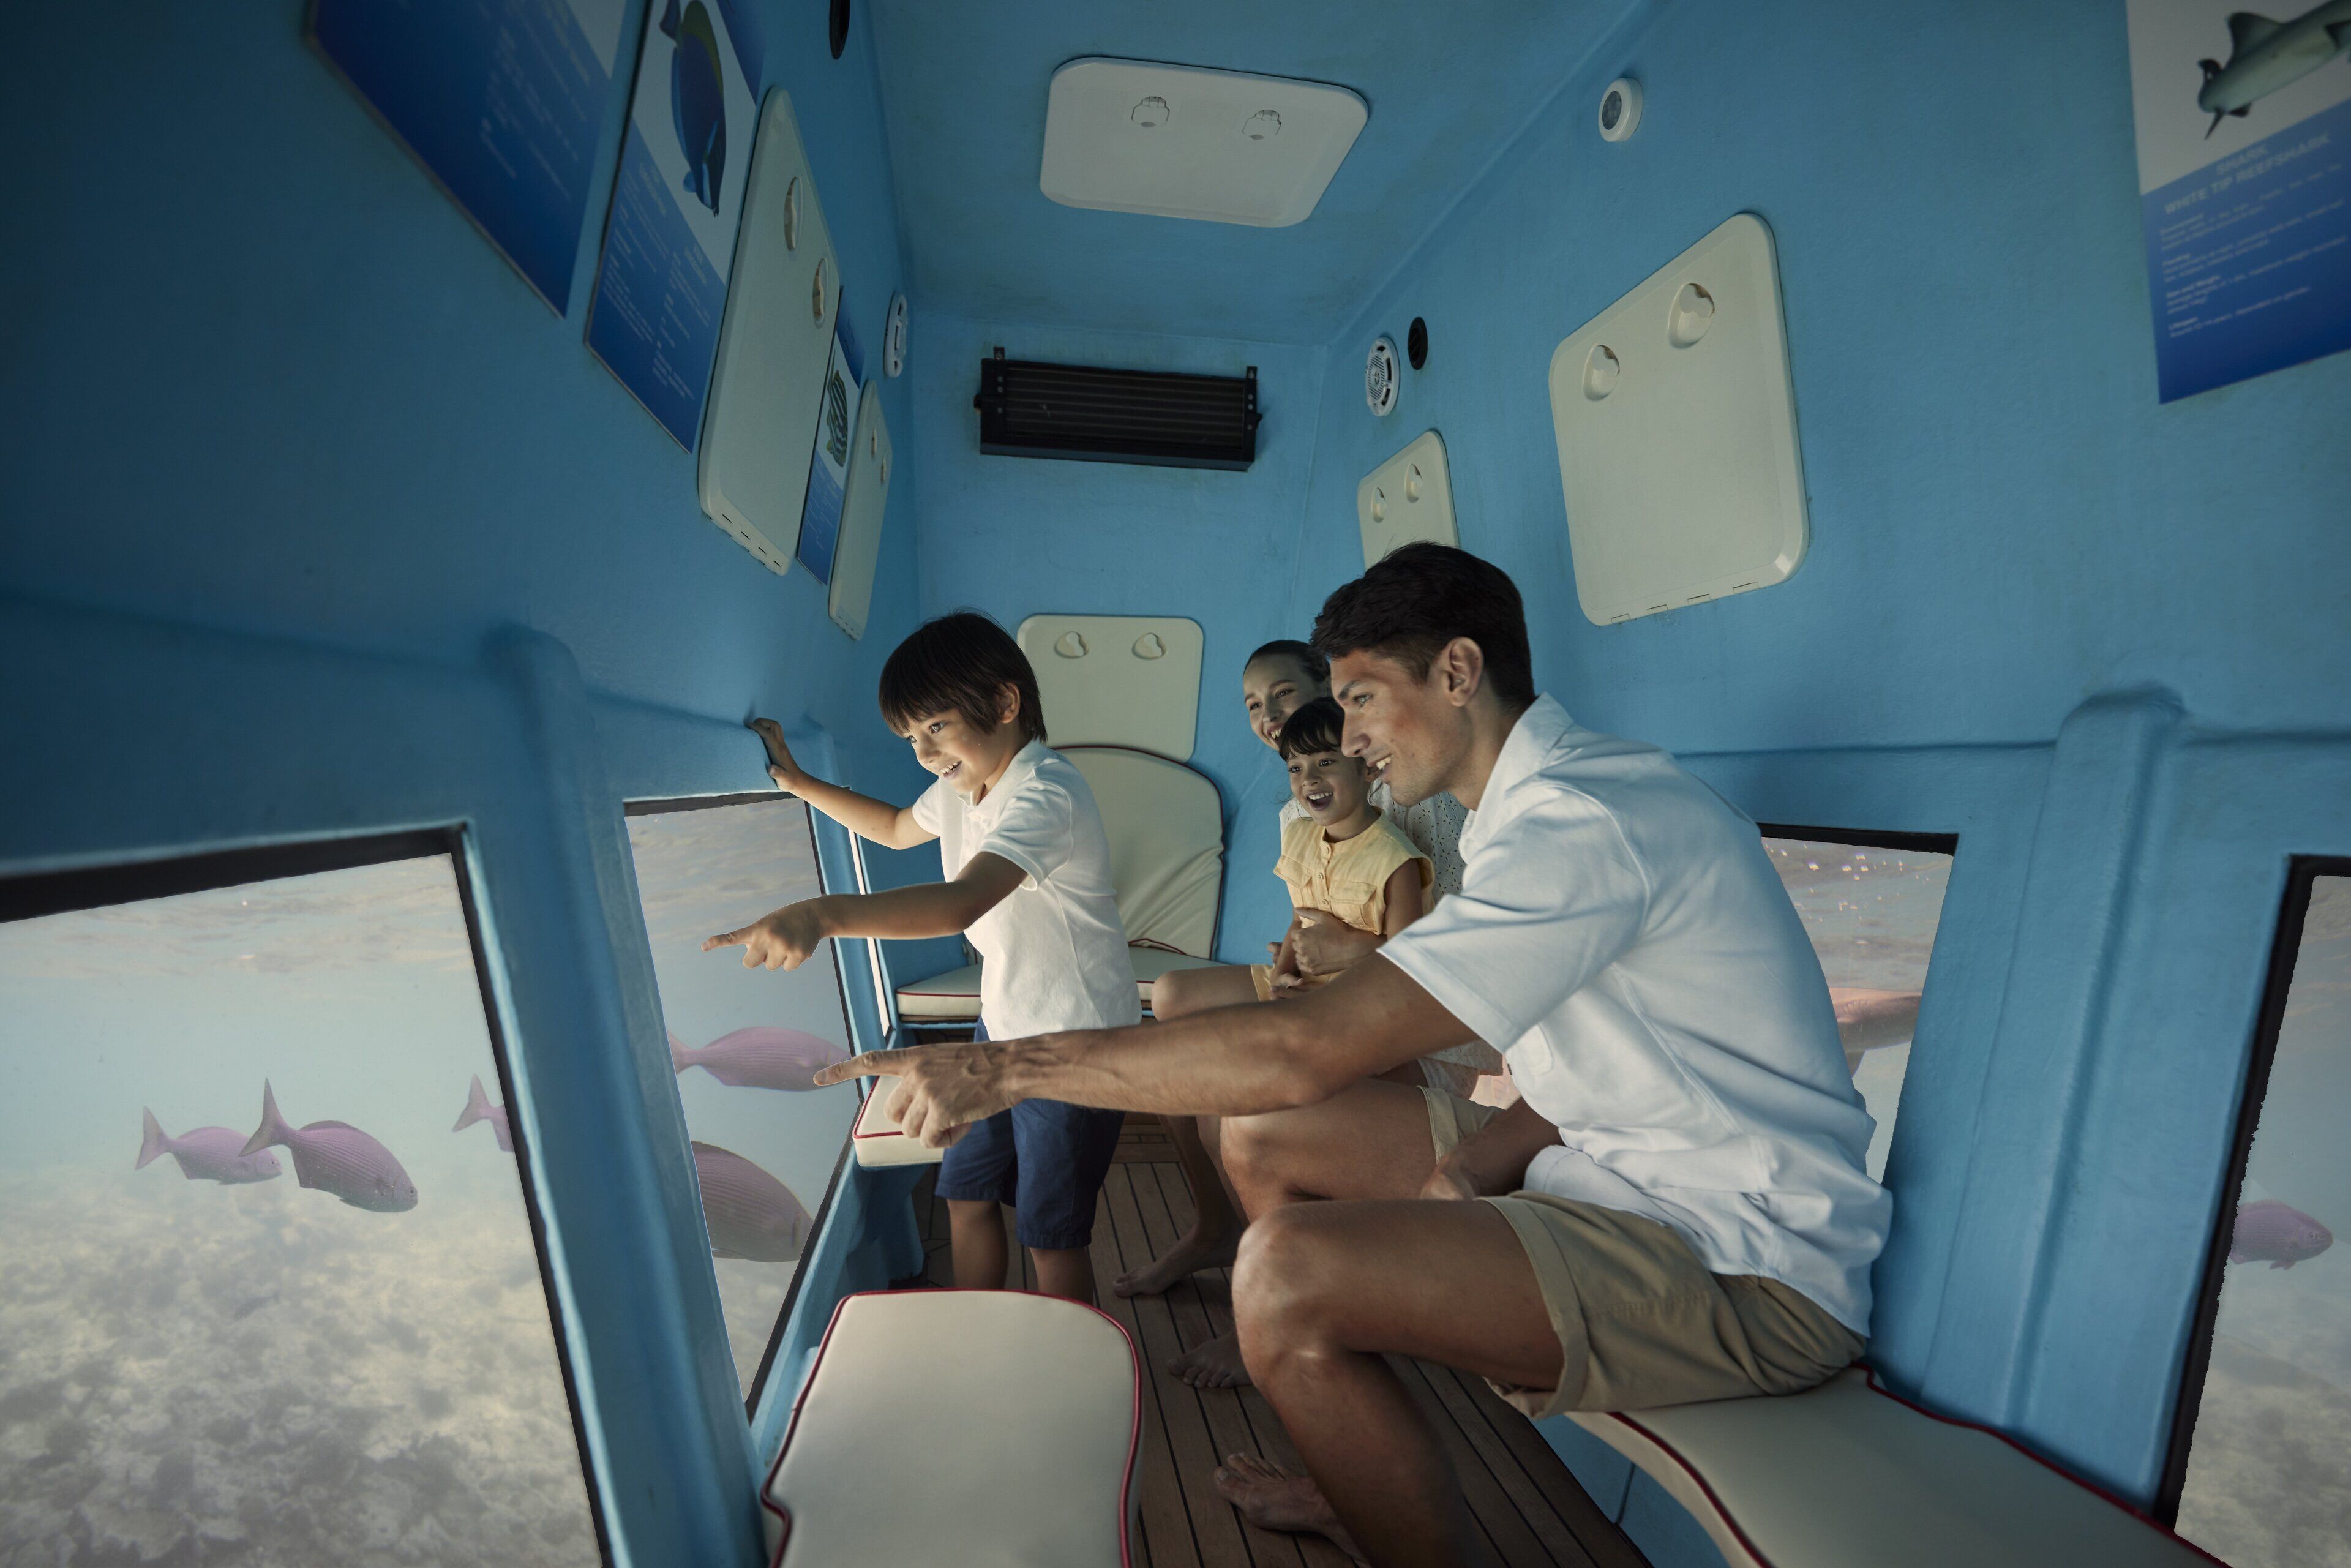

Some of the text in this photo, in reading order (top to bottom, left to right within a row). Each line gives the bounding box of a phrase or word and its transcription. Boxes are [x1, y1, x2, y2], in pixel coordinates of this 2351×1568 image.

[2216, 144, 2267, 176] SHARK
[2164, 187, 2207, 215] WHITE
[2211, 176, 2234, 195] TIP
